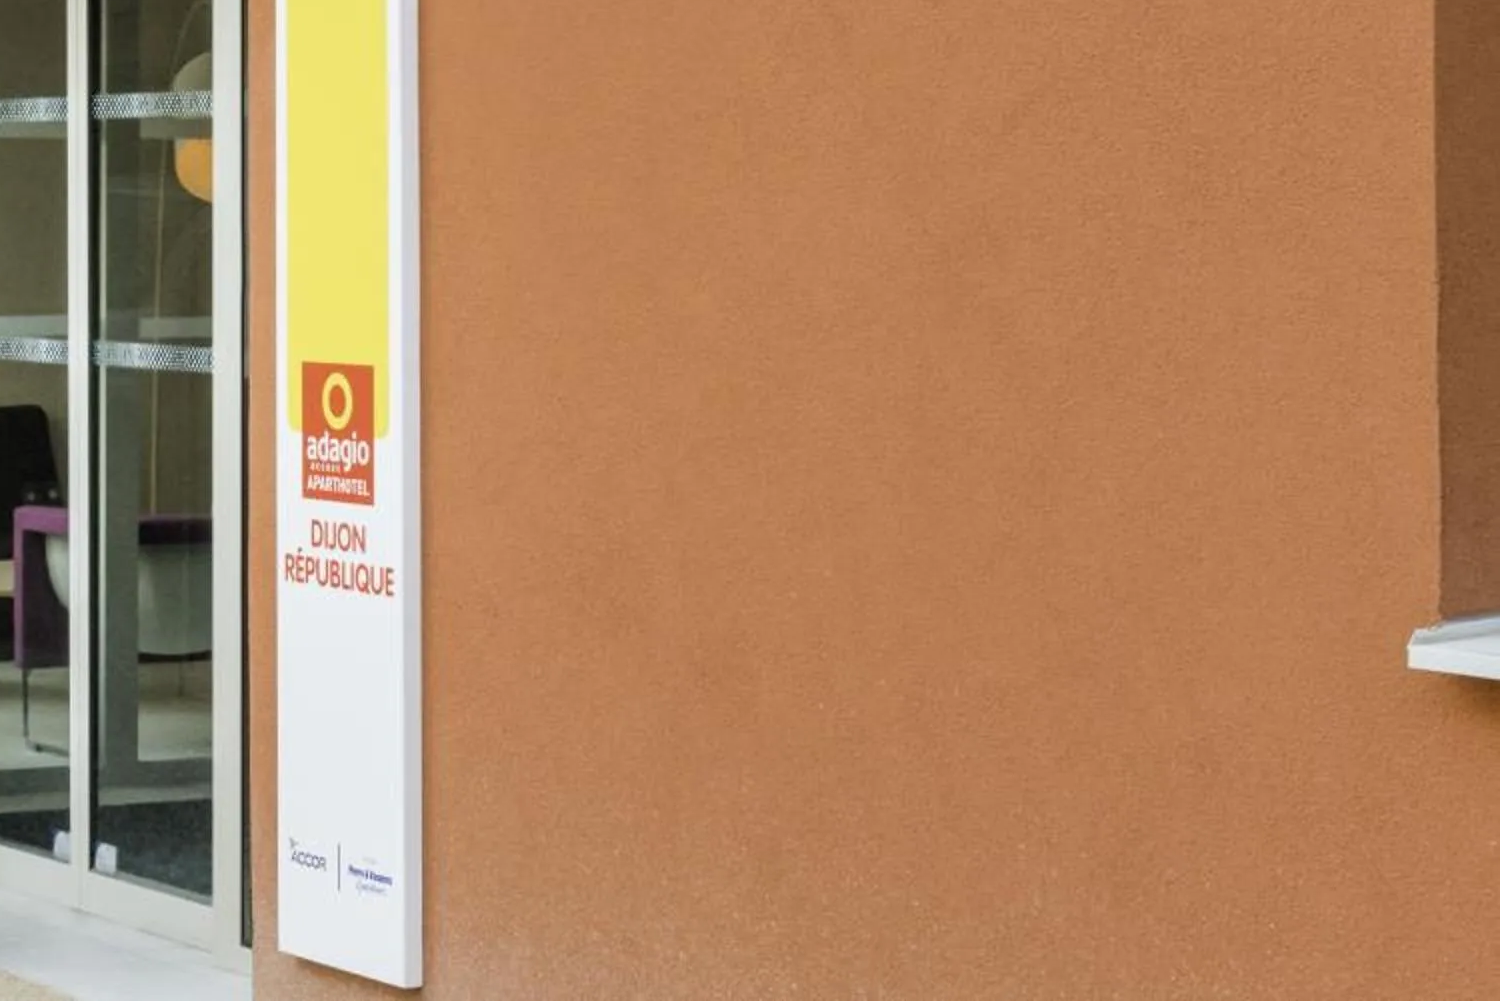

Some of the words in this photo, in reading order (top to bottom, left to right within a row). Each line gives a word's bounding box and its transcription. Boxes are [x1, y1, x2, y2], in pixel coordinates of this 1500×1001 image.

[306, 431, 370, 472] adagio
[307, 474, 371, 497] APARTHOTEL
[311, 519, 367, 554] DIJON
[285, 547, 395, 597] RÉPUBLIQUE
